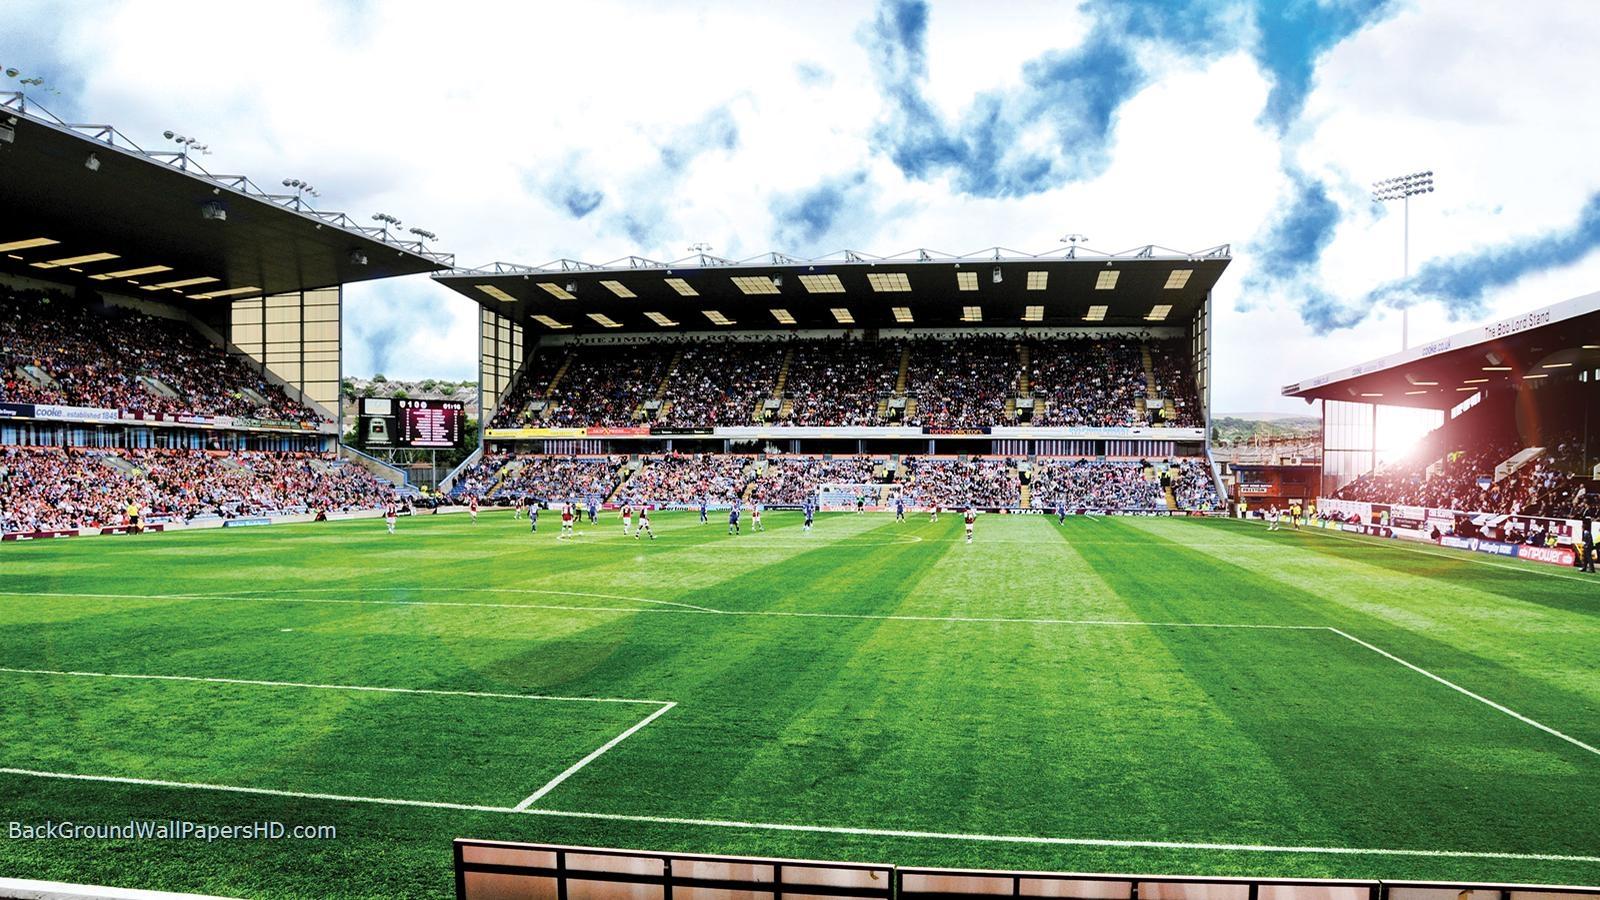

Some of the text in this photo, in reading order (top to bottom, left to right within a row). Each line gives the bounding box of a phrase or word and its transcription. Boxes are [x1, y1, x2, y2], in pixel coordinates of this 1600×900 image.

[1485, 308, 1551, 339] The Bob Lord Stand
[36, 407, 62, 417] cooke
